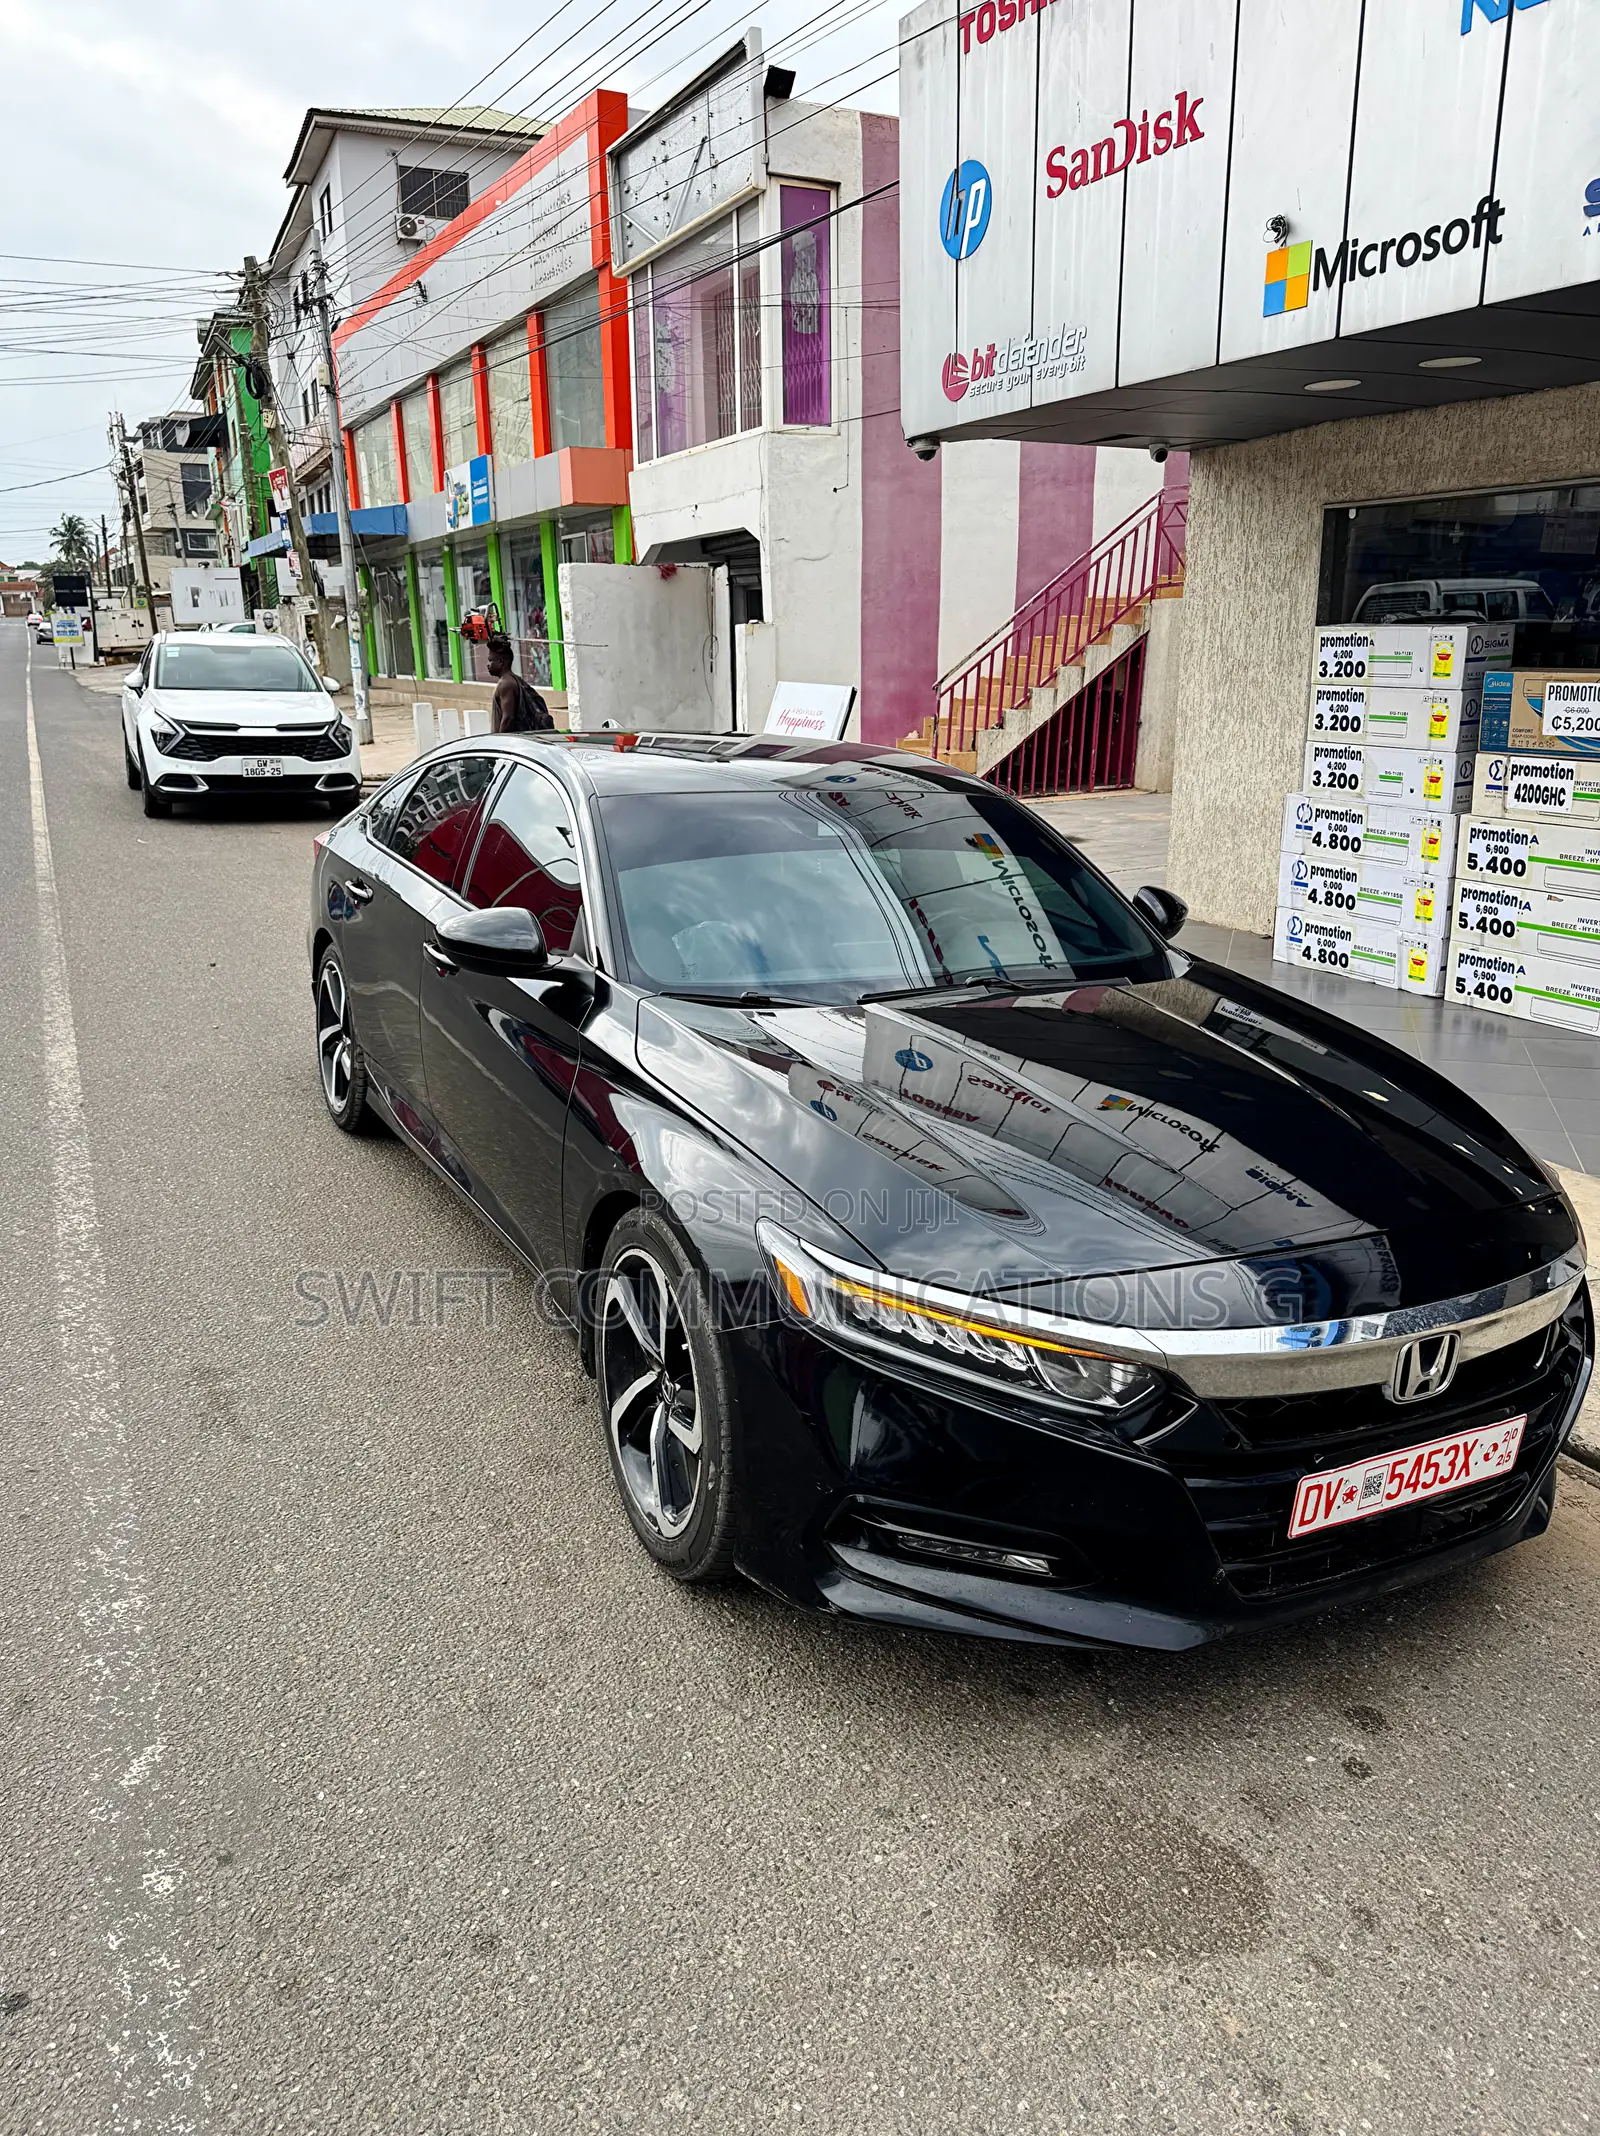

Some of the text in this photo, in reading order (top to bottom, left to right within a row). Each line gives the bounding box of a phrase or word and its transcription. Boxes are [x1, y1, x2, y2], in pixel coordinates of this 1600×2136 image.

[1046, 90, 1205, 199] SanDisk
[1312, 195, 1506, 292] Microsoft
[969, 378, 1003, 397] secure
[1006, 372, 1032, 392] your
[1320, 632, 1369, 652] promotion
[1484, 639, 1510, 649] SIGMA
[1333, 650, 1353, 659] 4,200
[1318, 660, 1366, 679] 3.200
[1316, 688, 1365, 705] promotion
[1329, 704, 1349, 714] 4,200
[776, 709, 826, 735] Happiness
[1314, 713, 1361, 733] 3.200
[257, 759, 268, 768] GW
[1314, 746, 1362, 762] promotion
[1327, 762, 1347, 771] 4,200
[1510, 762, 1574, 781] promotion
[1312, 770, 1359, 791] 3.200
[1514, 783, 1566, 807] 4200GHC
[1314, 807, 1364, 825] promotion
[1328, 823, 1348, 834] 6,000
[1367, 827, 1386, 835] BREEZE
[1469, 826, 1529, 846] promotion
[1311, 831, 1362, 854] 4.800
[1485, 843, 1510, 856] 6,900
[1467, 852, 1527, 878] 5.400
[1559, 853, 1586, 862] BREEZE
[1310, 864, 1358, 883] promotion
[1323, 880, 1343, 891] 6,000
[1360, 886, 1379, 895] BREEZE
[1307, 888, 1356, 911] 4.800
[1461, 886, 1519, 908] promotion
[1475, 904, 1499, 916] 6,900
[1304, 921, 1352, 942] promotion
[1458, 912, 1516, 938] 5.400
[1551, 920, 1577, 931] BREEZE
[1316, 938, 1337, 949] 6,000
[1353, 944, 1374, 954] BREEZE
[1302, 945, 1349, 969] 4.800
[1458, 952, 1515, 975] promotion
[1473, 969, 1497, 982] 6,900
[1455, 976, 1513, 1005] 5.400
[1545, 985, 1571, 996] BREEZE
[1298, 1438, 1479, 1529] DV 5453X
